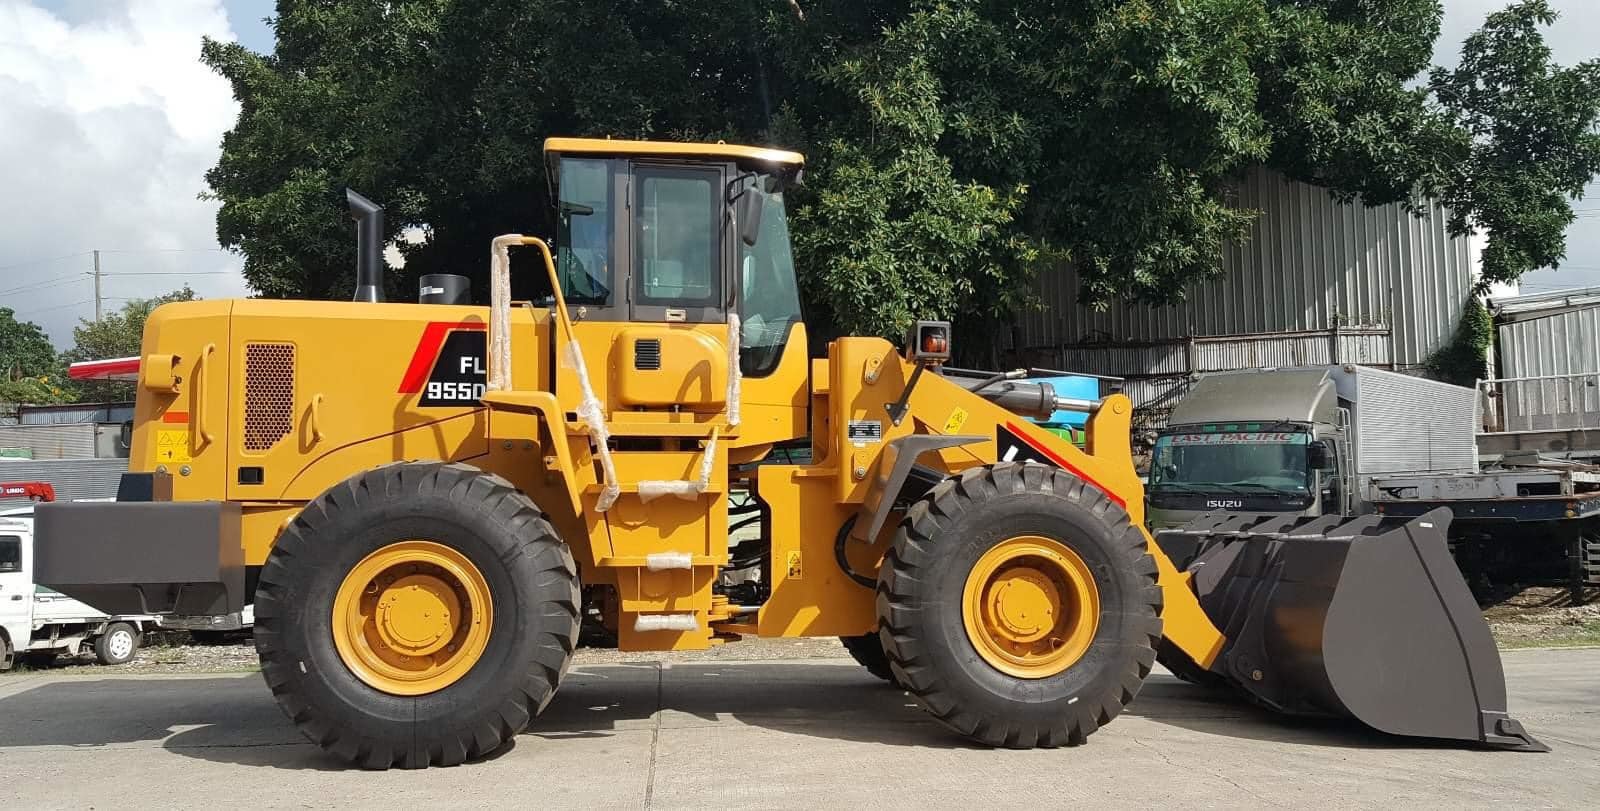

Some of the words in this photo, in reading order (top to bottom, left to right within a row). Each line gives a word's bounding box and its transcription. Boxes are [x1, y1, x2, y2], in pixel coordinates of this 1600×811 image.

[460, 356, 486, 374] FL
[427, 382, 486, 400] 955D
[1171, 434, 1211, 443] EAST
[1221, 432, 1295, 442] PACIFIC
[1206, 500, 1242, 508] ISUZU
